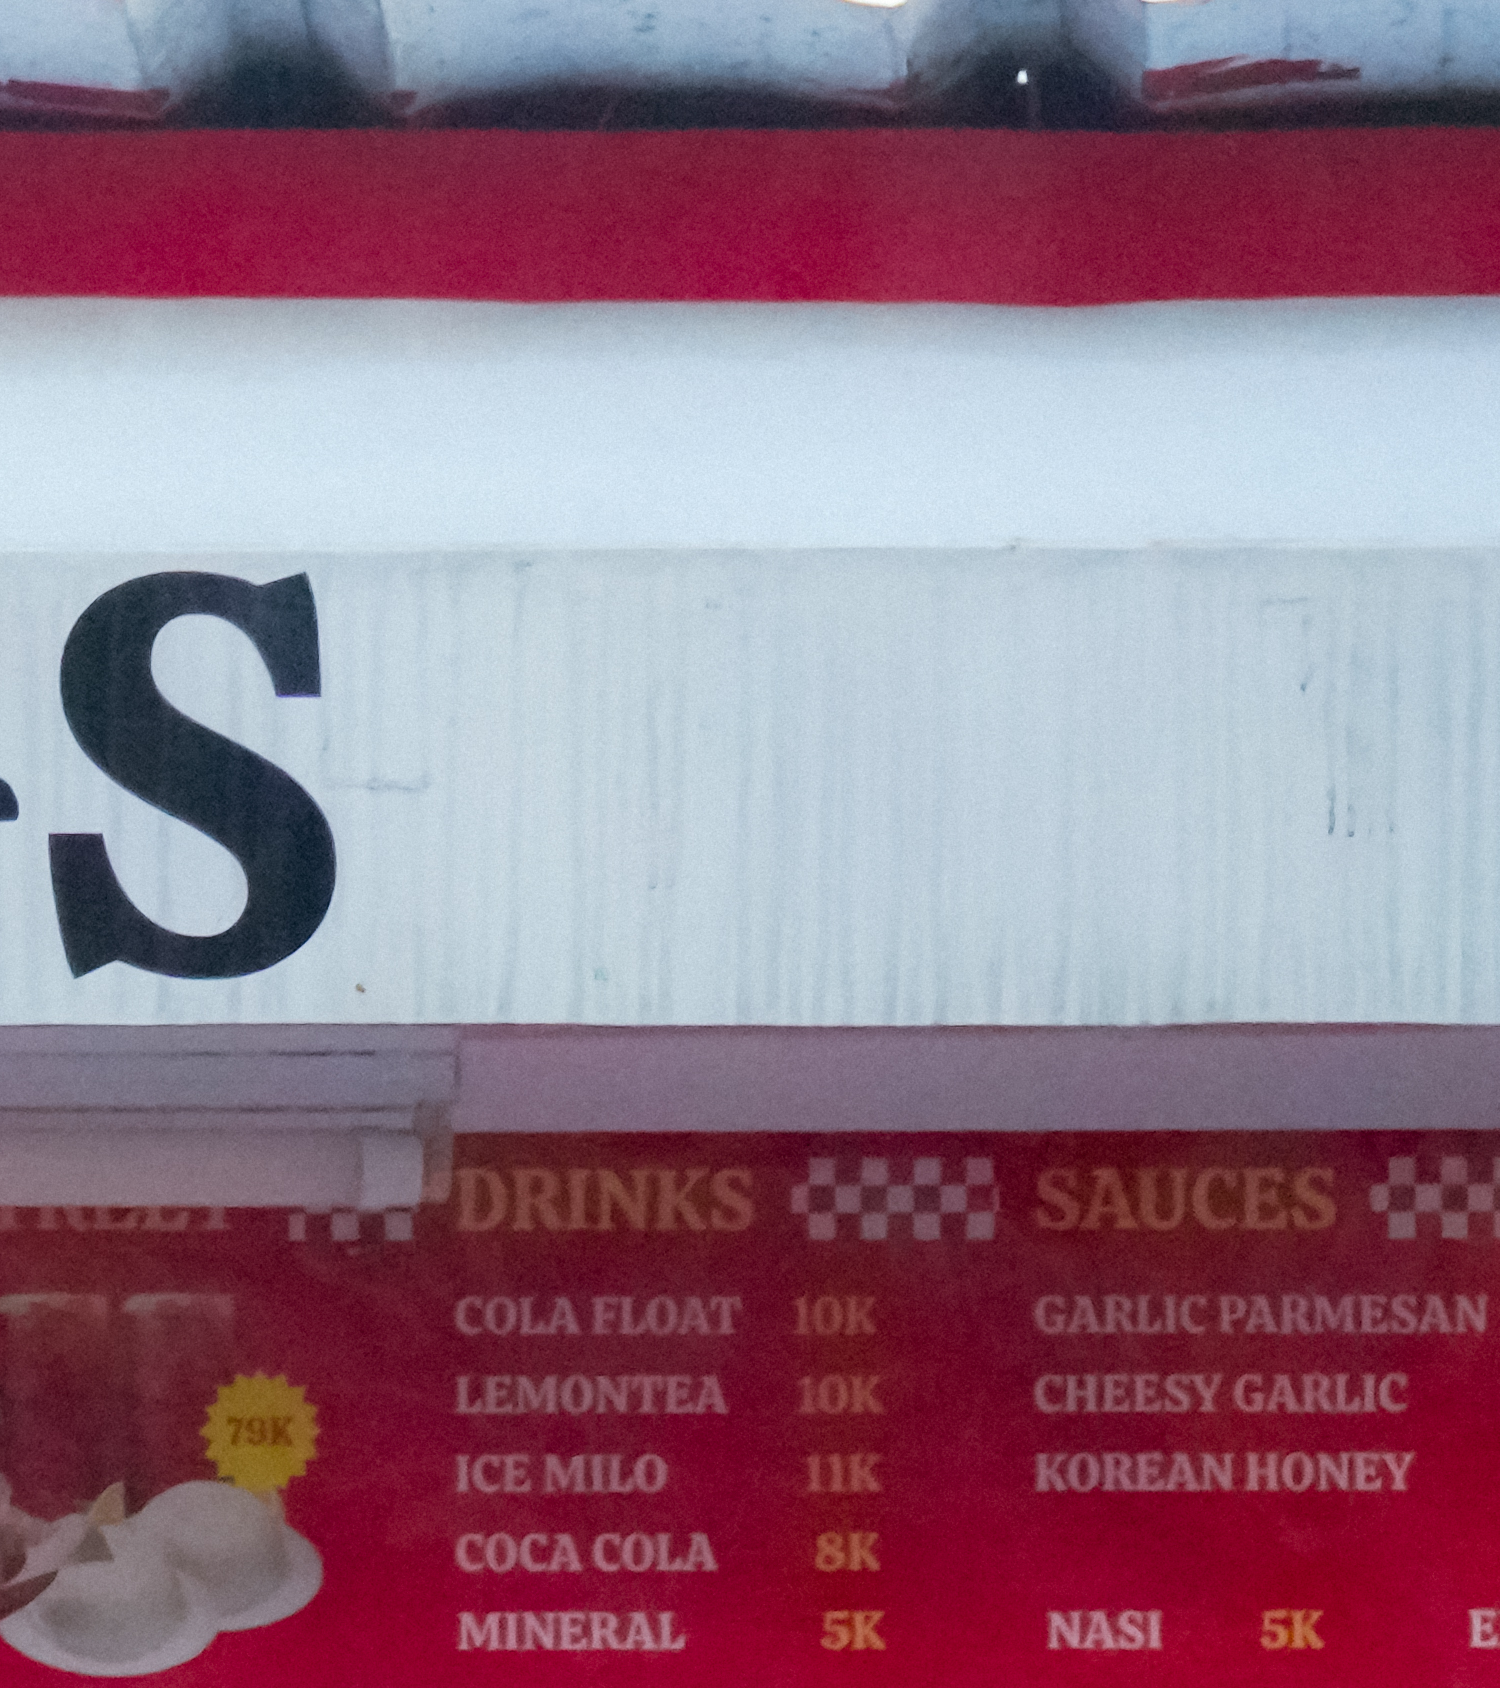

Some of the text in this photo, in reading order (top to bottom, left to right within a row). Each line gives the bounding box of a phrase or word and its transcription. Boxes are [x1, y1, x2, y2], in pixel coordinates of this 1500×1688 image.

[456, 1168, 755, 1232] DRINKS
[1036, 1167, 1337, 1232] SAUCES
[455, 1297, 876, 1336] COLA FLOAT 10K
[1035, 1295, 1488, 1335] GARLIC PARMESAN
[455, 1376, 884, 1414] LEMONTEA 10K
[1035, 1374, 1408, 1414] CHEESY GARLIC
[226, 1417, 293, 1448] 79K
[455, 1453, 884, 1494] ICE MILO 11K
[1035, 1452, 1415, 1493] KOREAN HONEY
[455, 1532, 881, 1572] COCA COLA 8K
[457, 1611, 885, 1651] MINERAL 5K
[1047, 1611, 1162, 1651] NASI
[1260, 1611, 1324, 1651] 5K
